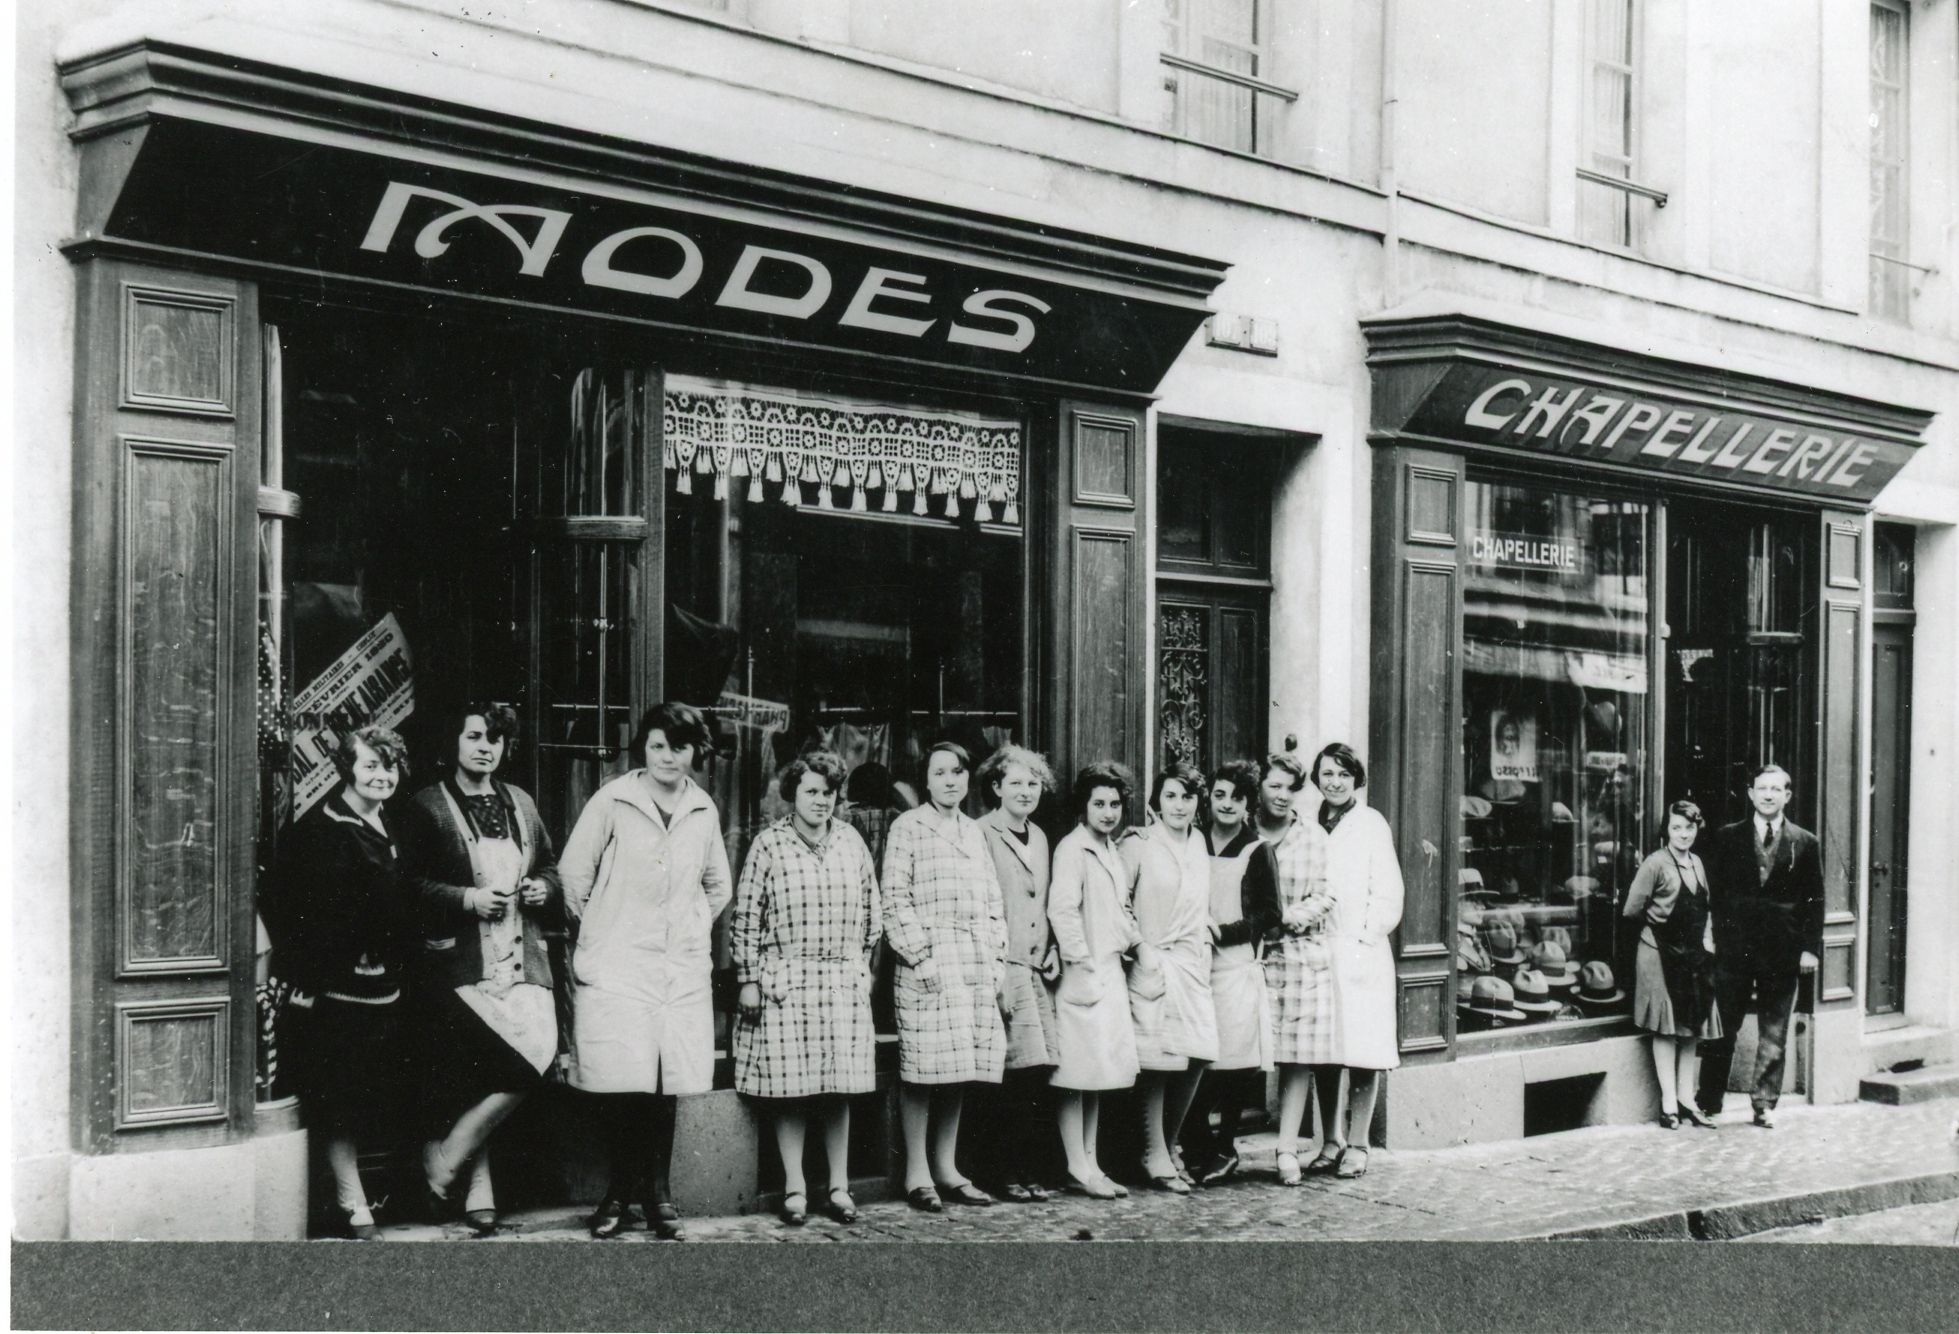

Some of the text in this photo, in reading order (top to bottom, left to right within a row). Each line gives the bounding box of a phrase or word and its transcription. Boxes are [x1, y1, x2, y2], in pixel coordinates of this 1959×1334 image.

[360, 181, 1052, 353] MODES
[1464, 379, 1879, 487] CHAPELLERIE
[1472, 536, 1576, 568] CHAPELLERIE
[307, 662, 362, 711] ÉVRIER
